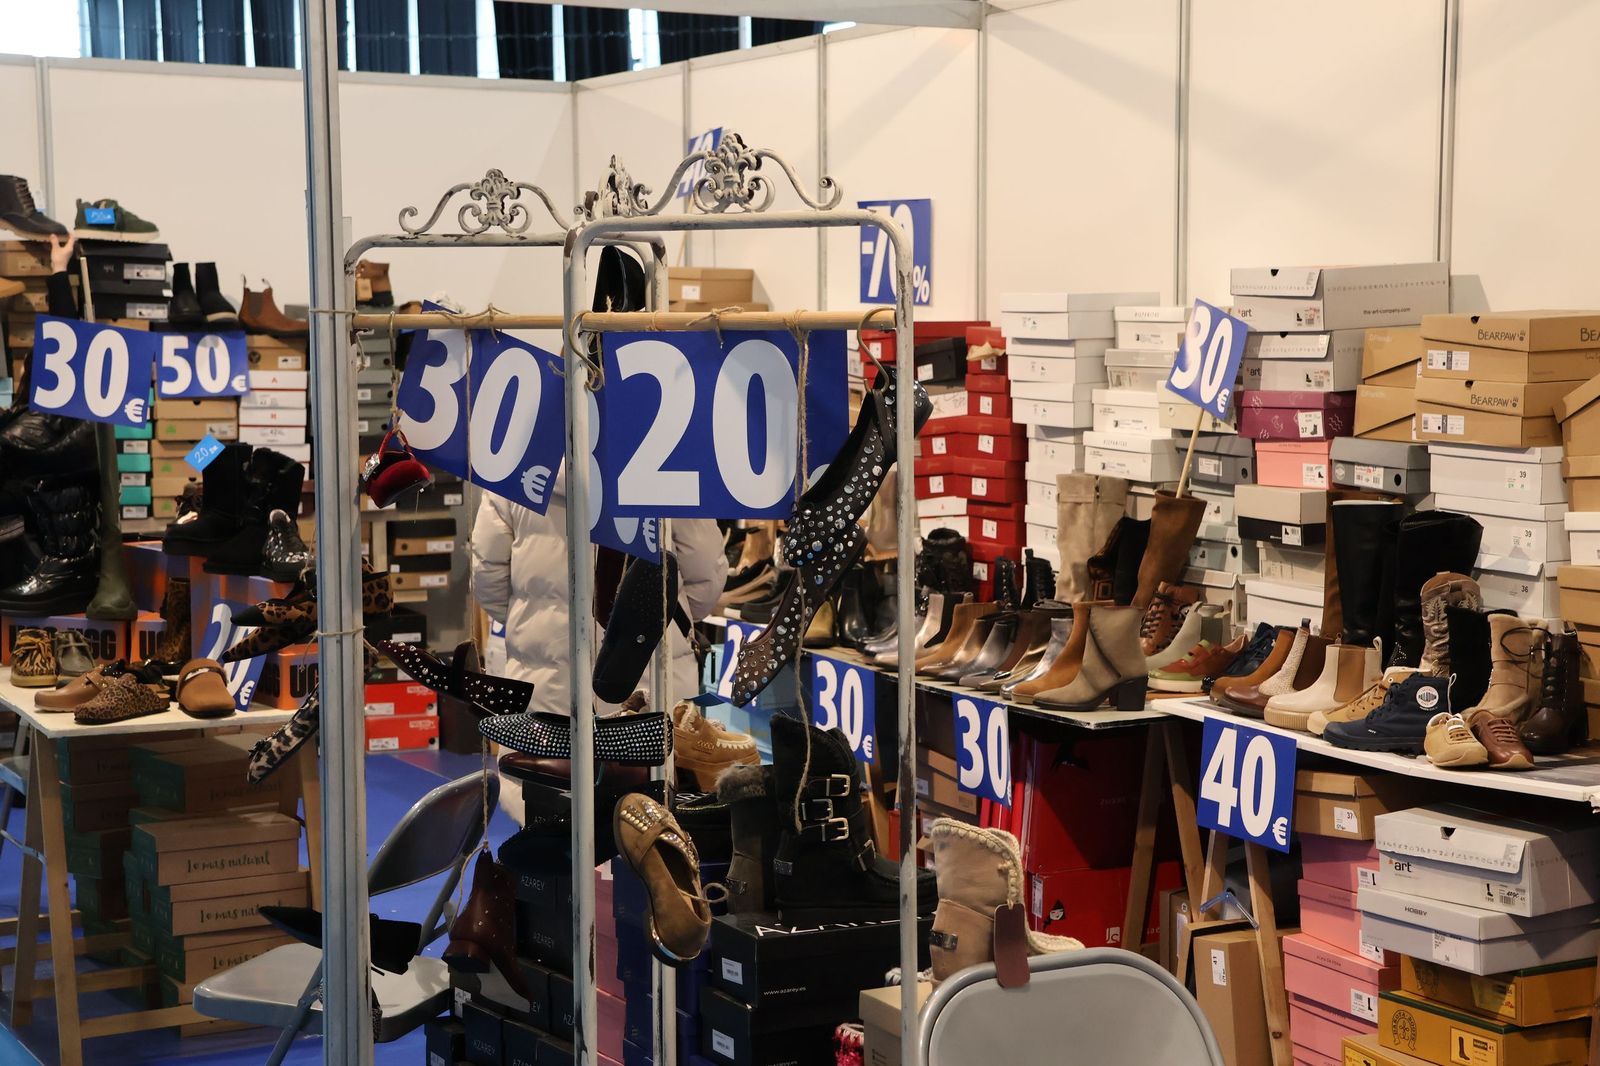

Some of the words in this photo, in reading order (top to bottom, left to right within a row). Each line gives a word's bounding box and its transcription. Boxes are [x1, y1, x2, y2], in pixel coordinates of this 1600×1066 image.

[1477, 329, 1516, 342] BEARPAW
[34, 321, 145, 423] 30€
[161, 334, 247, 395] 50€
[1171, 306, 1232, 413] 30€
[399, 328, 551, 504] 30€
[1470, 394, 1509, 408] BEARPAW
[1519, 470, 1527, 478] 39
[1524, 529, 1532, 538] 39
[816, 660, 873, 758] 30€
[957, 699, 1012, 804] 30
[1201, 727, 1288, 846] 40€
[1346, 811, 1353, 820] 37
[1394, 861, 1412, 873] art
[1404, 906, 1427, 916] HOBBY
